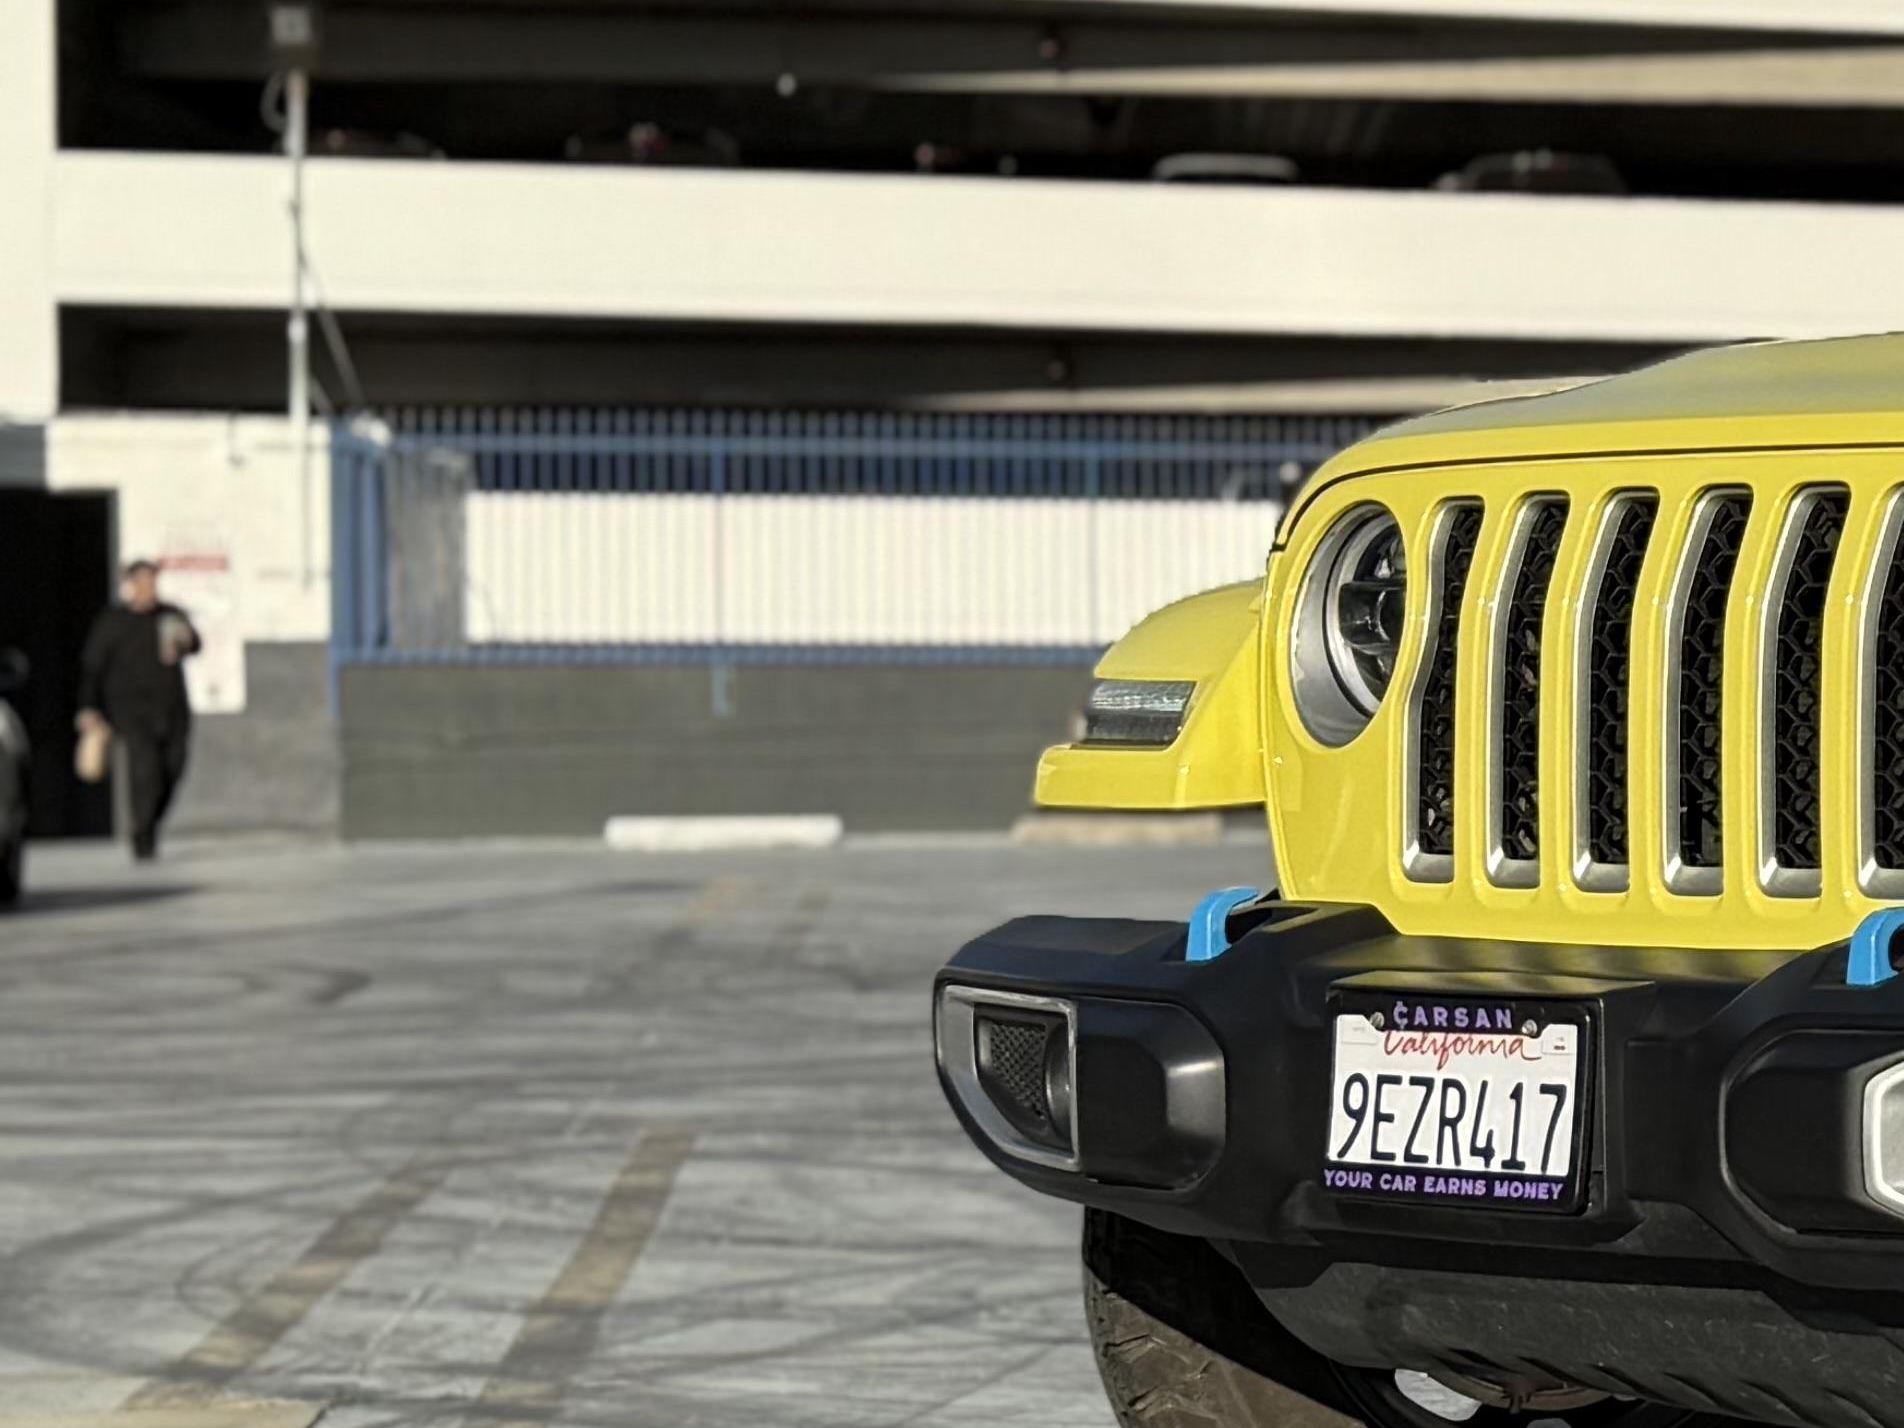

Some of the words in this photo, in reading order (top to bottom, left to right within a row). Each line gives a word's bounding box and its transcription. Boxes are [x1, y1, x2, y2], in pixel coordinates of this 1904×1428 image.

[1394, 1001, 1512, 1029] CARSAN
[1384, 1029, 1541, 1071] California
[1337, 1072, 1567, 1174] 9EZR417
[1324, 1169, 1373, 1189] YOUR
[1380, 1173, 1416, 1193] CAR
[1424, 1176, 1487, 1197] EARNS
[1492, 1179, 1564, 1201] MONEY
